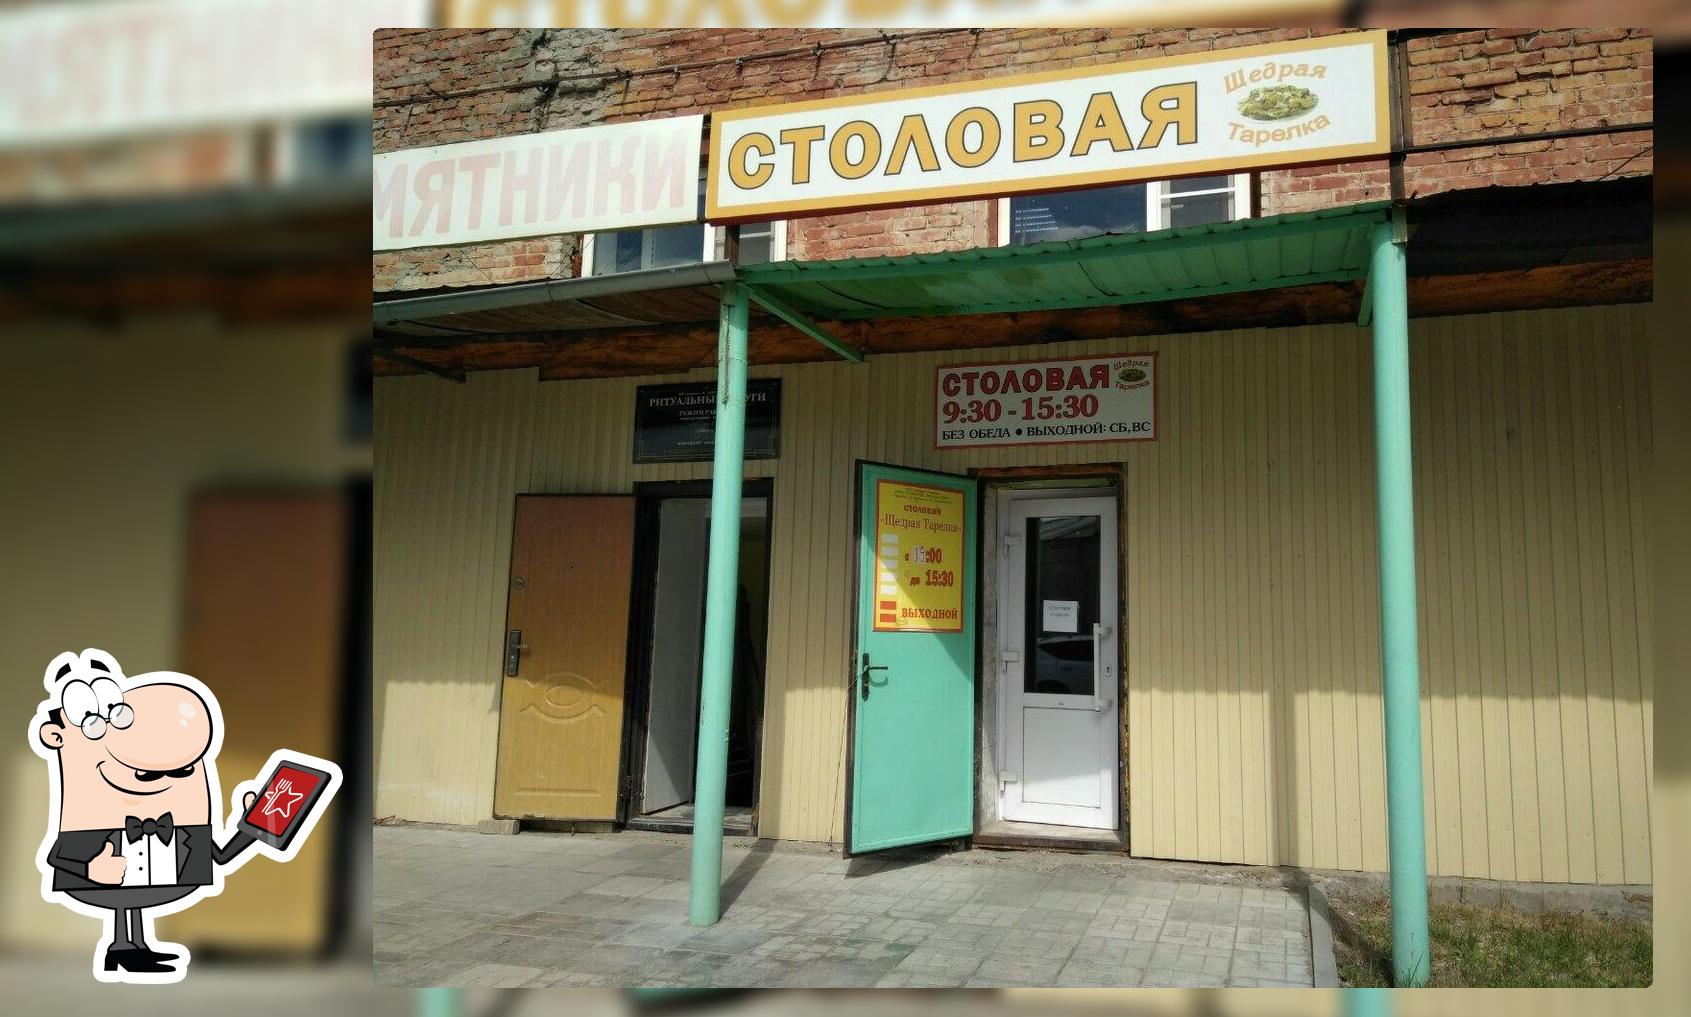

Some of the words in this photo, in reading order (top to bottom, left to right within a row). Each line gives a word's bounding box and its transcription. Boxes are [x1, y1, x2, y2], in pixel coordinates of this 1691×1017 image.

[1223, 62, 1328, 94] Щедрая
[727, 81, 1198, 190] СТОЛОВАЯ
[1228, 114, 1331, 147] Тарелка
[942, 364, 1110, 397] СТОЛОВАЯ
[649, 395, 717, 407] РИТУАЛЬНЫ
[942, 399, 1002, 424] 9:30
[1021, 394, 1099, 421] 15:30
[942, 429, 965, 440] БЕЗ
[969, 427, 1011, 439] ОБЕДА
[1027, 421, 1107, 437] ВЫХОДНОЙ:
[925, 569, 954, 588] 15:30
[902, 607, 958, 620] ВЫХОДНОЙ
